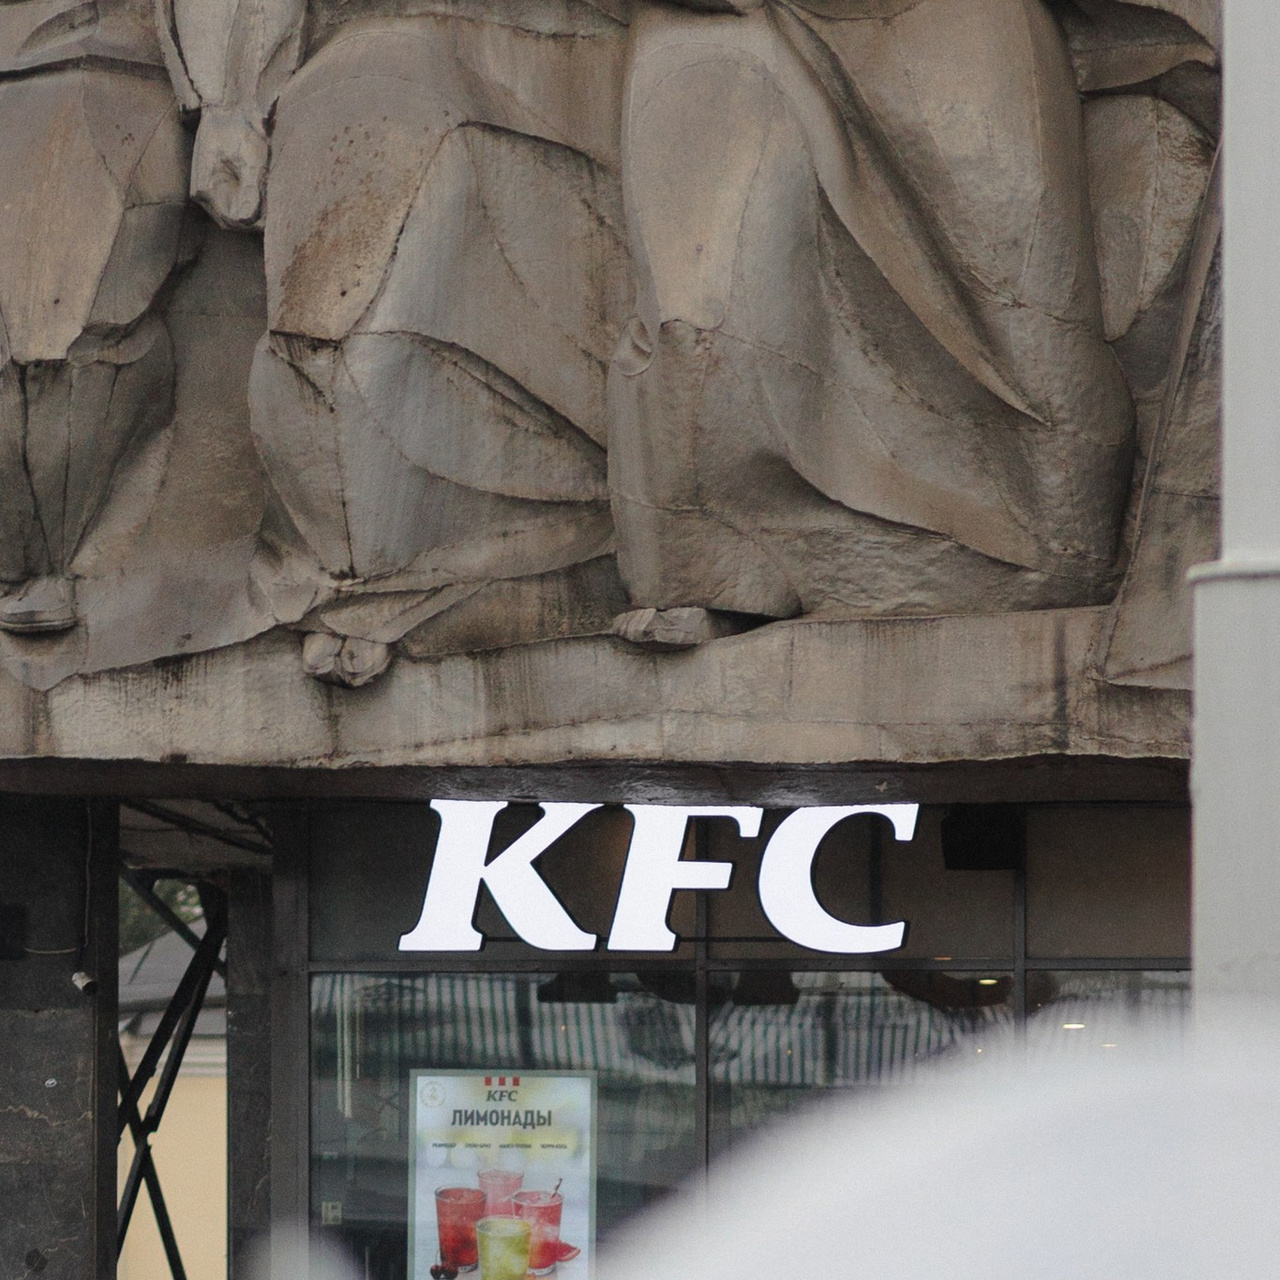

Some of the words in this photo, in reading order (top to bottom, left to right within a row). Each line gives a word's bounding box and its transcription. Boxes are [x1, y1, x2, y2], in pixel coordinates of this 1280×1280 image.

[398, 799, 919, 954] KFC
[486, 1090, 518, 1102] KFC
[451, 1109, 552, 1129] ЛИМОНАДЫ
